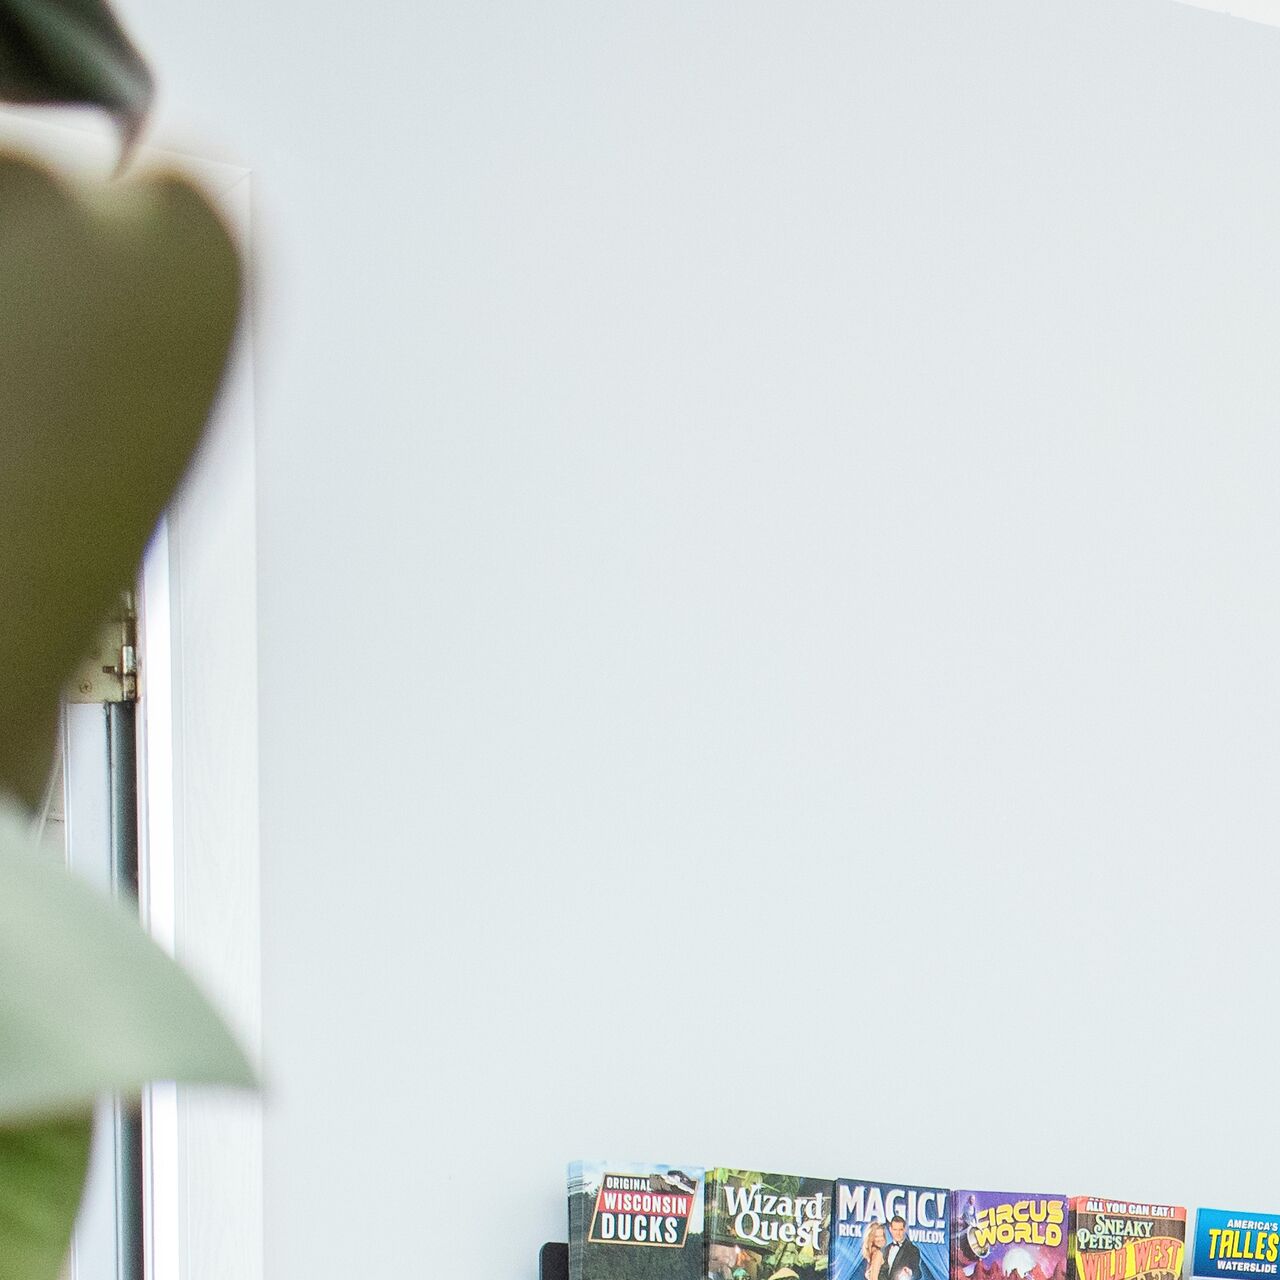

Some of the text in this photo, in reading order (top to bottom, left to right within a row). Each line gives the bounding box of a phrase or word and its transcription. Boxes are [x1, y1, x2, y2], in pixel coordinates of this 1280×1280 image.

[606, 1177, 650, 1190] ORIGINAL
[603, 1193, 687, 1214] WISCONSIN
[724, 1183, 824, 1220] Wizard
[838, 1184, 947, 1229] MAGIC!
[975, 1199, 1065, 1228] CIRCUS
[1086, 1200, 1105, 1213] ALL
[1106, 1202, 1127, 1214] YOU
[1128, 1204, 1150, 1216] CAN
[600, 1213, 678, 1243] DUCKS
[735, 1212, 821, 1250] Quest
[838, 1223, 862, 1238] RICK
[908, 1229, 945, 1244] WILCOX
[974, 1222, 1062, 1247] WORLD
[1093, 1214, 1154, 1239] SNEAKY
[1226, 1219, 1279, 1231] AMERICA'S
[1078, 1228, 1122, 1251] PETE'S
[1134, 1241, 1181, 1272] WEST
[1216, 1260, 1278, 1274] WATERSLIDE
